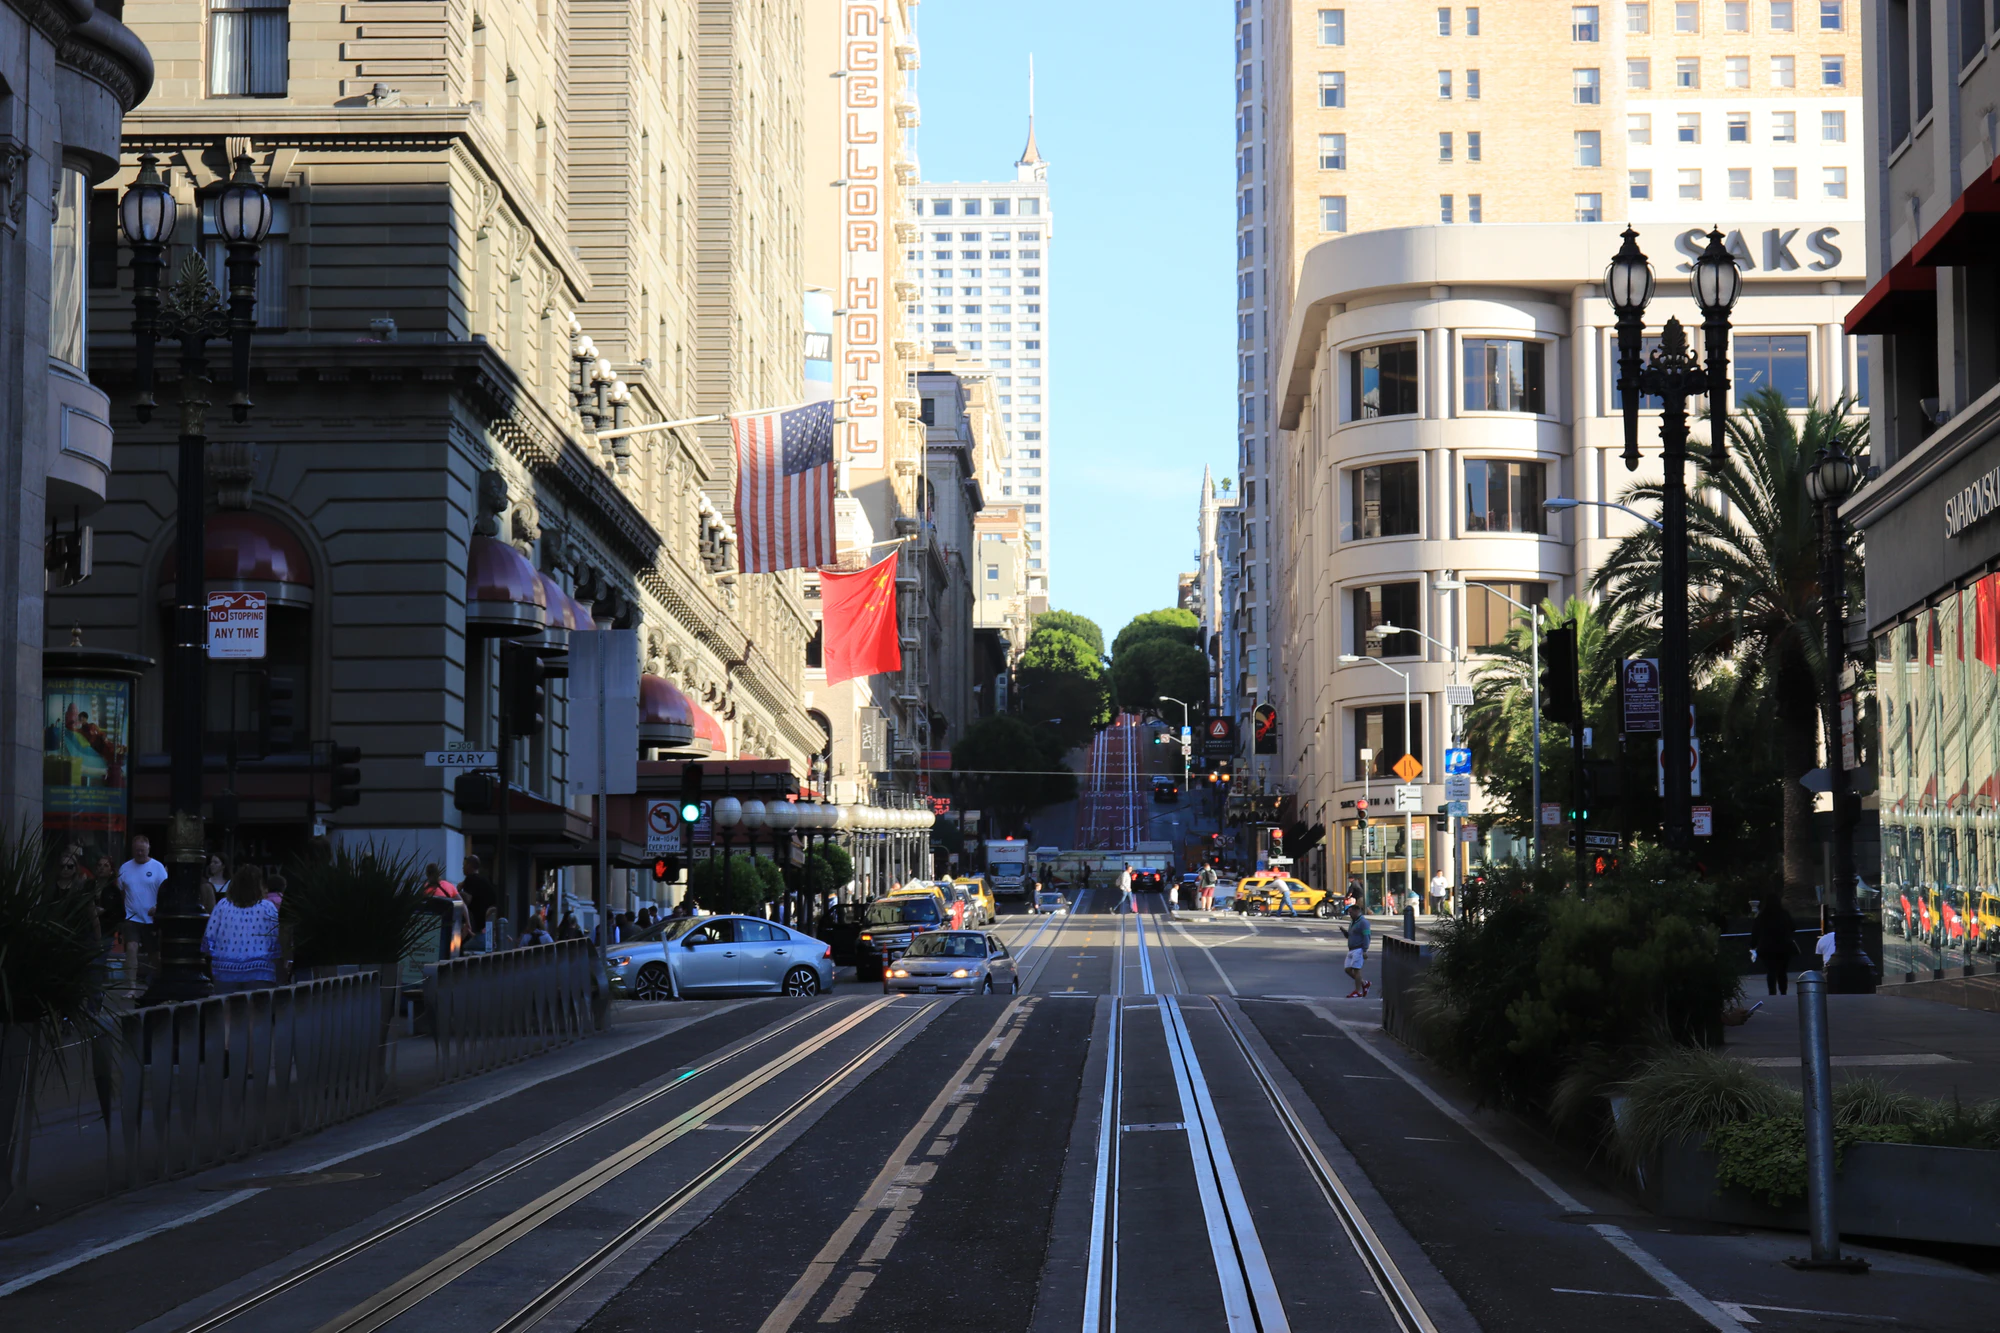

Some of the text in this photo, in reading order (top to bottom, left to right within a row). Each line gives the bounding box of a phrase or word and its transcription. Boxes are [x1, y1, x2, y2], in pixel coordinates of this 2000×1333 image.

[1676, 227, 1842, 273] SAKS
[803, 334, 829, 358] OW!
[845, 277, 880, 453] HOTEL
[1945, 466, 2000, 539] SWAROVSKI
[210, 611, 264, 621] NO STOPPING
[214, 627, 260, 639] ANY TIME
[862, 722, 872, 750] DSW
[437, 754, 485, 764] GEARY
[648, 844, 678, 852] EVERYDAY
[1599, 836, 1614, 845] WAY
